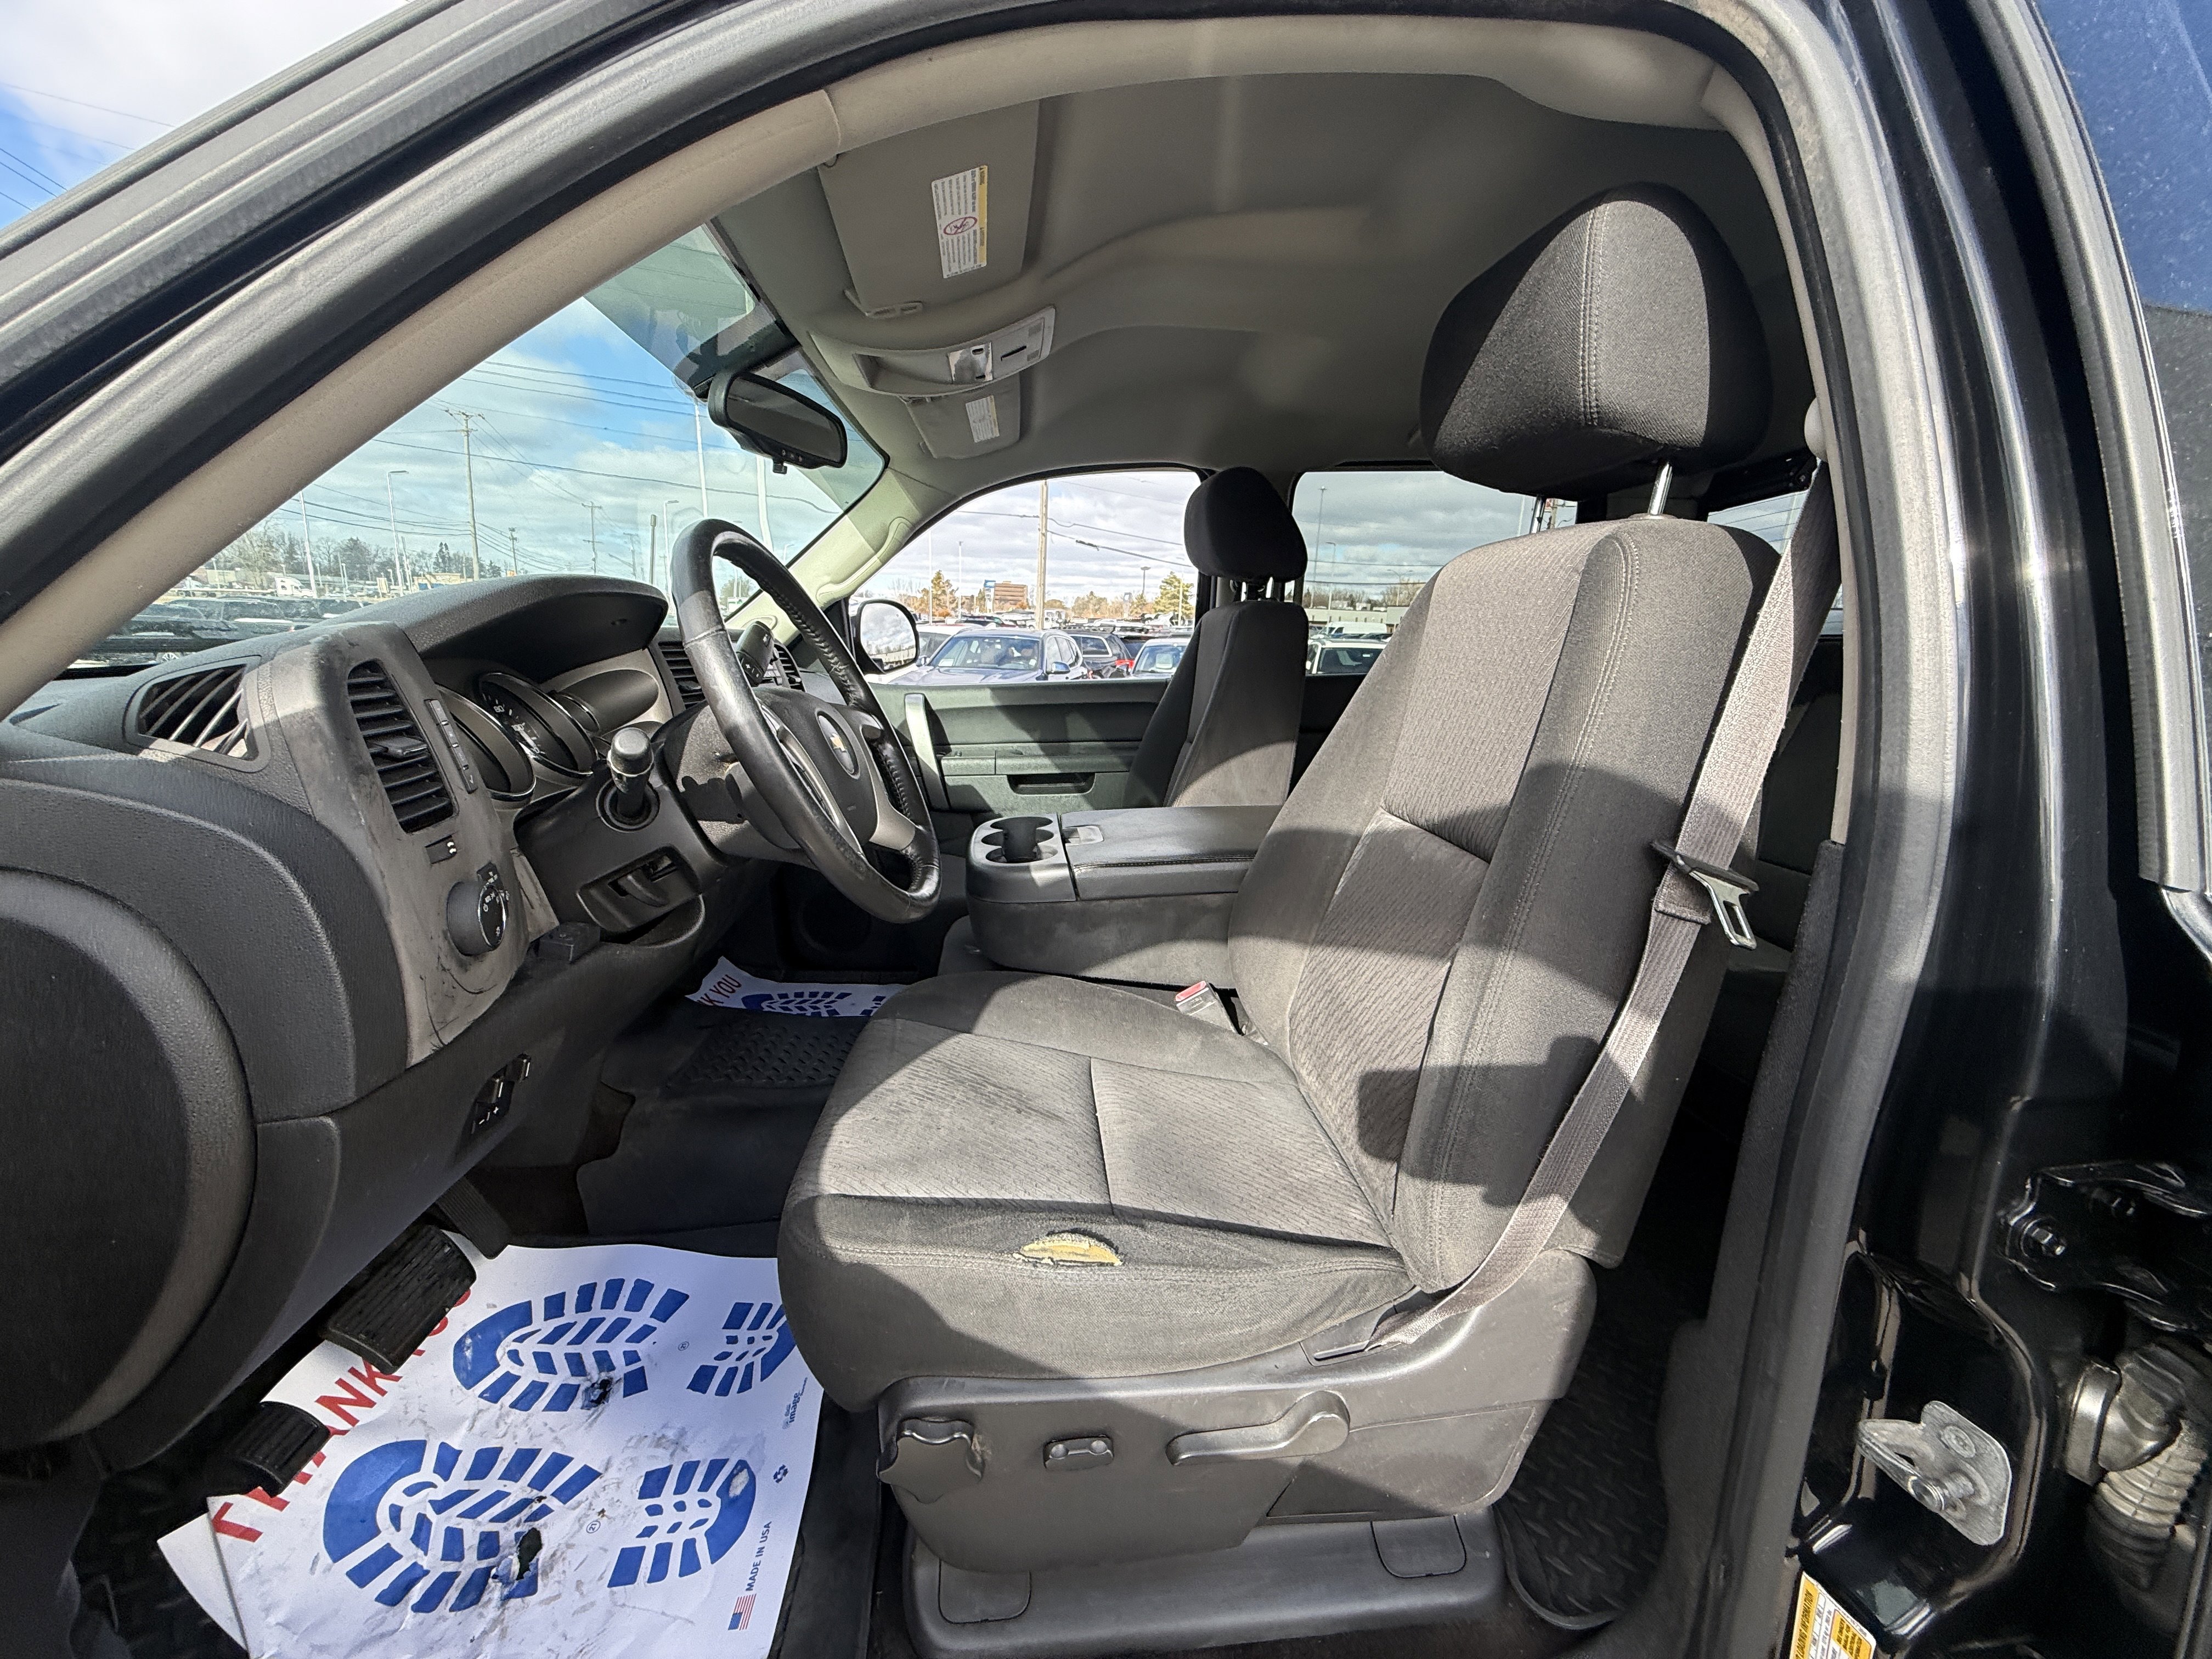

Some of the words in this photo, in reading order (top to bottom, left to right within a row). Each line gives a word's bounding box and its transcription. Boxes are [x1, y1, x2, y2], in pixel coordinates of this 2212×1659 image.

[709, 974, 742, 998] YOU
[759, 1521, 772, 1543] USA
[755, 1546, 765, 1558] IN
[746, 1560, 761, 1591] MADE
[1800, 1589, 1814, 1633] INFORMATION
